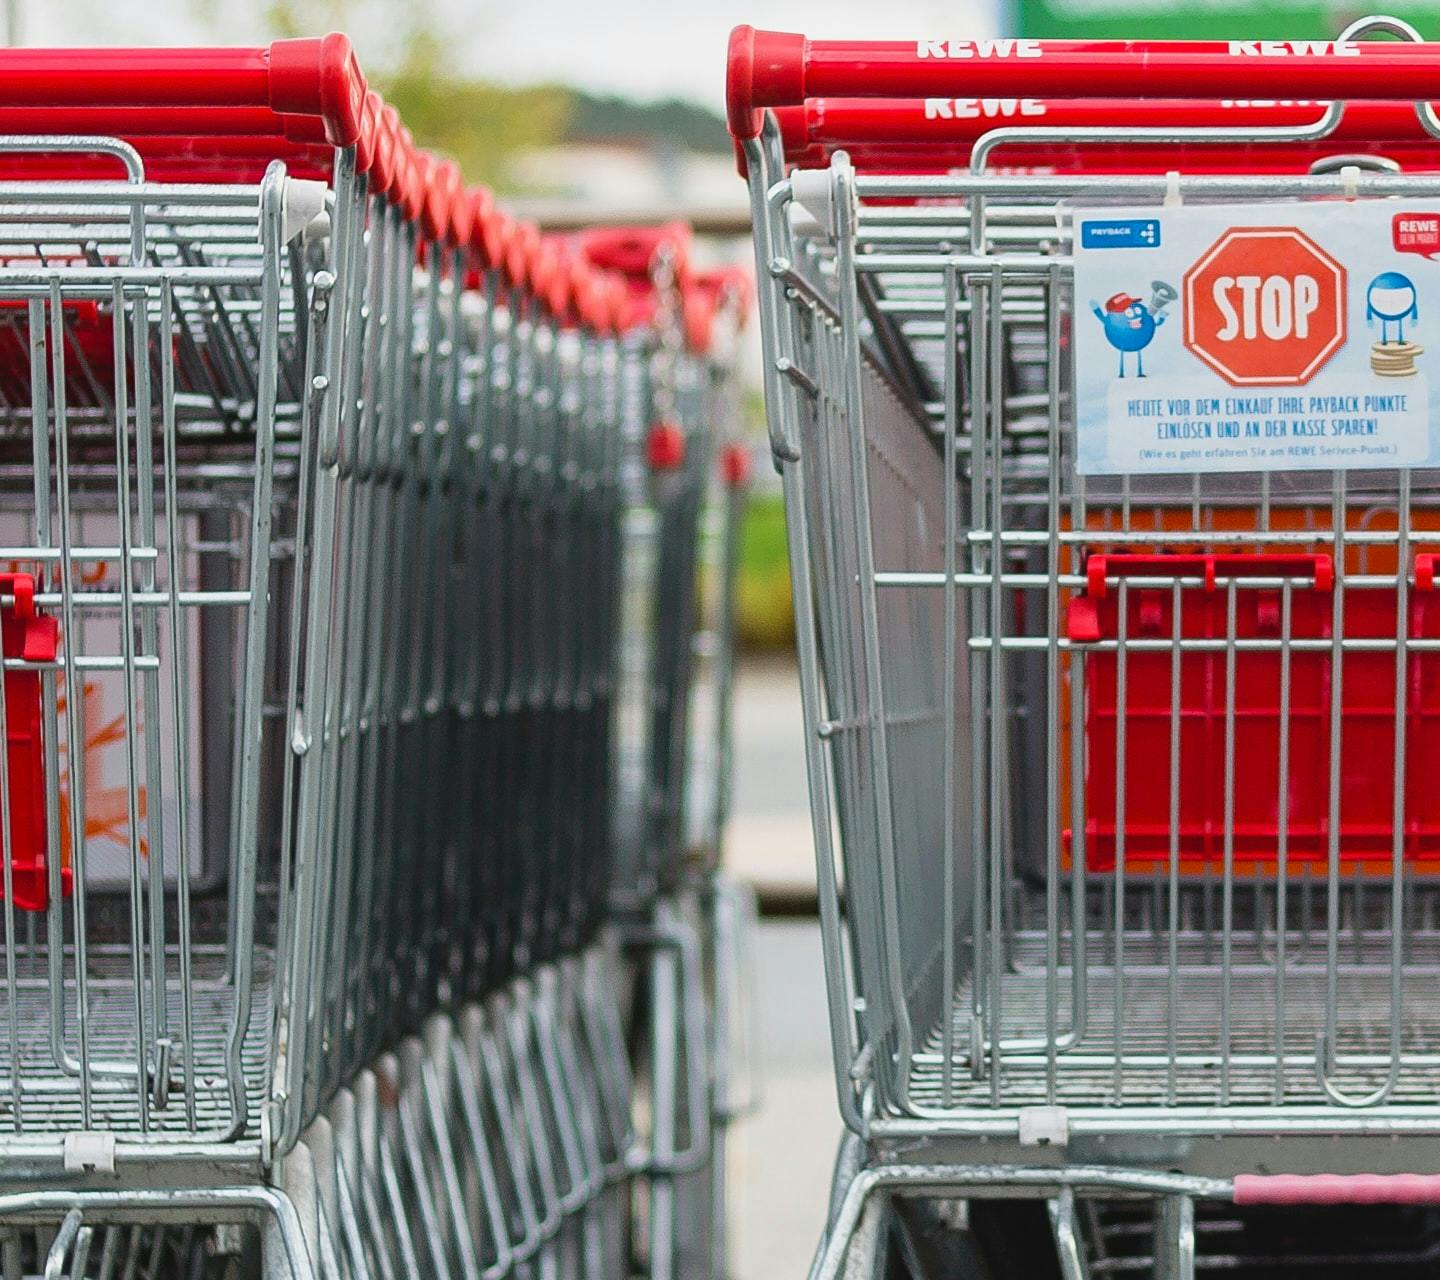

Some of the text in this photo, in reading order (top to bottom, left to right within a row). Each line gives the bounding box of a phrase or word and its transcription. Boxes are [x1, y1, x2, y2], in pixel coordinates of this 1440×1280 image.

[923, 98, 1048, 119] REWE
[1400, 220, 1439, 232] REWE
[1212, 274, 1320, 342] STOP
[1128, 394, 1408, 417] HEUTE VOR DEM EINKAUF IHRE PAYBACK PUNKTE
[1157, 418, 1378, 440] EINLÖSEN UND AN DER KASSE SPAREN!
[1139, 448, 1162, 460] (Wie
[1165, 450, 1177, 458] es
[1180, 449, 1202, 460] geht
[1205, 447, 1248, 458] erfahren
[1251, 446, 1266, 456] Sie
[1270, 448, 1285, 456] am
[1288, 445, 1316, 456] REWE
